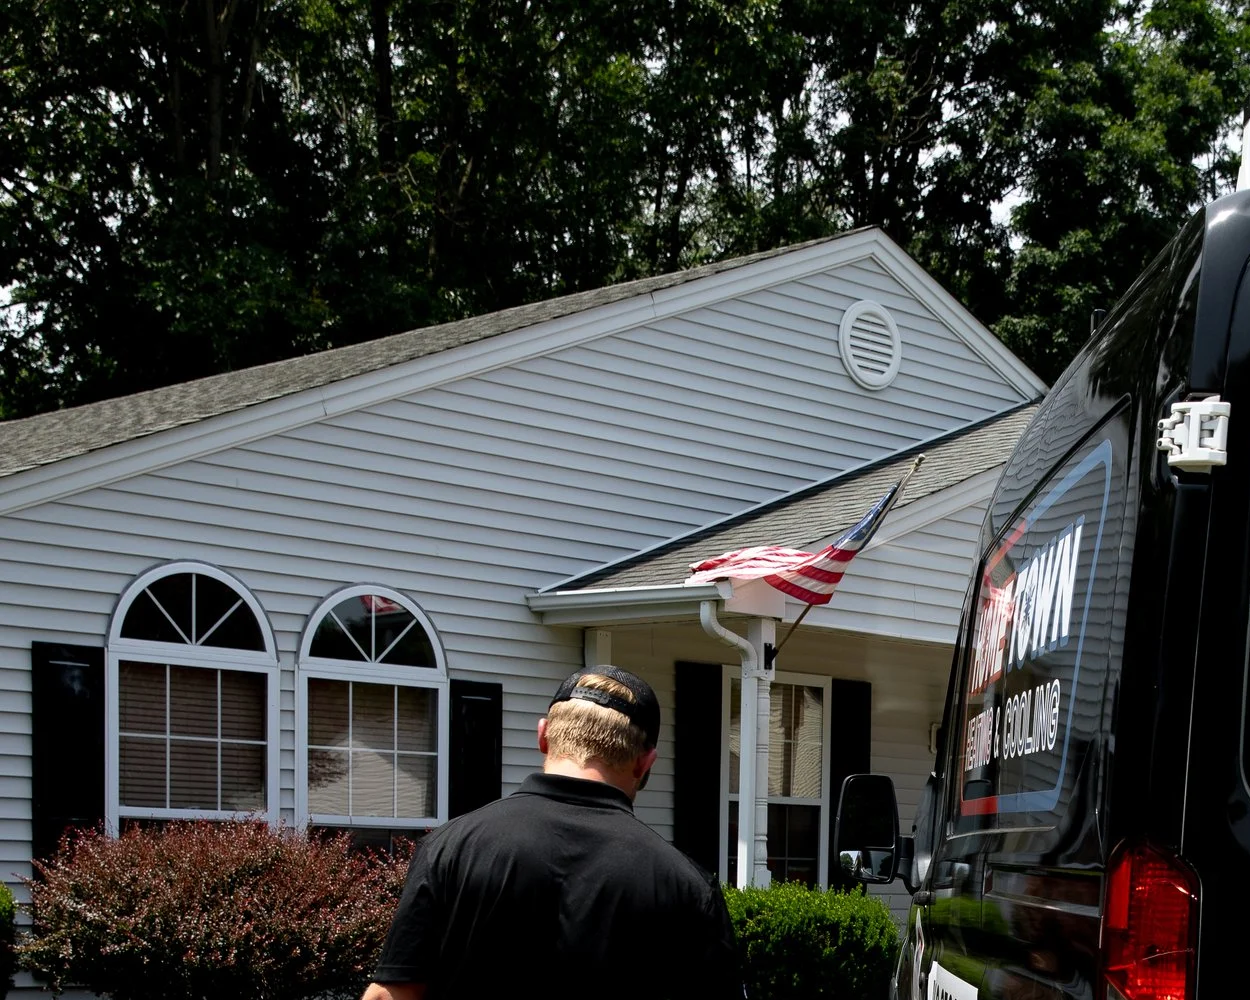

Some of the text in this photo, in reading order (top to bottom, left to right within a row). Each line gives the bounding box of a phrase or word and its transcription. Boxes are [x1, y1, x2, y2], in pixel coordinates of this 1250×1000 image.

[1007, 518, 1085, 669] TOWN
[994, 706, 1001, 759] &
[1003, 678, 1061, 760] COOLING
